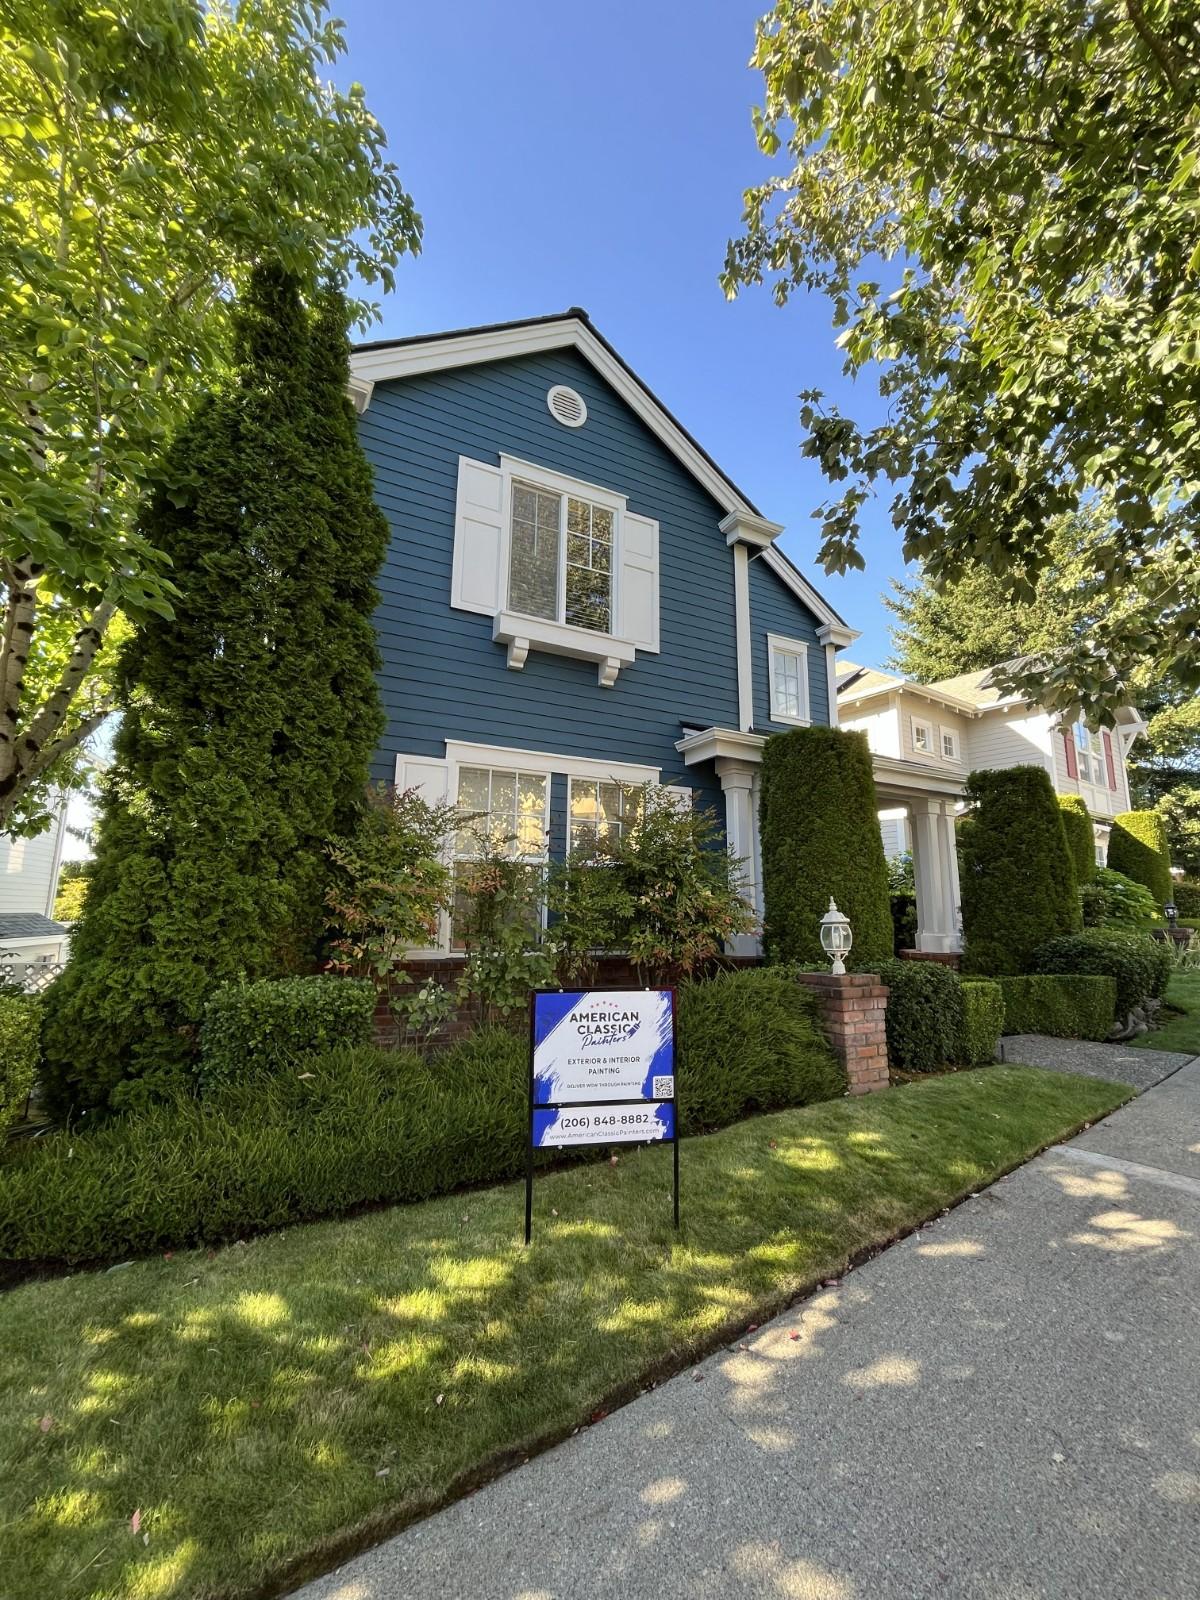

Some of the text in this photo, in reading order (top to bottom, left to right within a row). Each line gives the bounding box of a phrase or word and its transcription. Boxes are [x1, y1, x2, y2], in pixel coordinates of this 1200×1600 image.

[570, 1012, 639, 1022] AMERICAN
[577, 1024, 631, 1035] CLASSIC
[581, 1030, 627, 1050] Painters
[588, 1067, 620, 1075] PAINTING
[561, 1114, 649, 1129] (206) 848-8882
